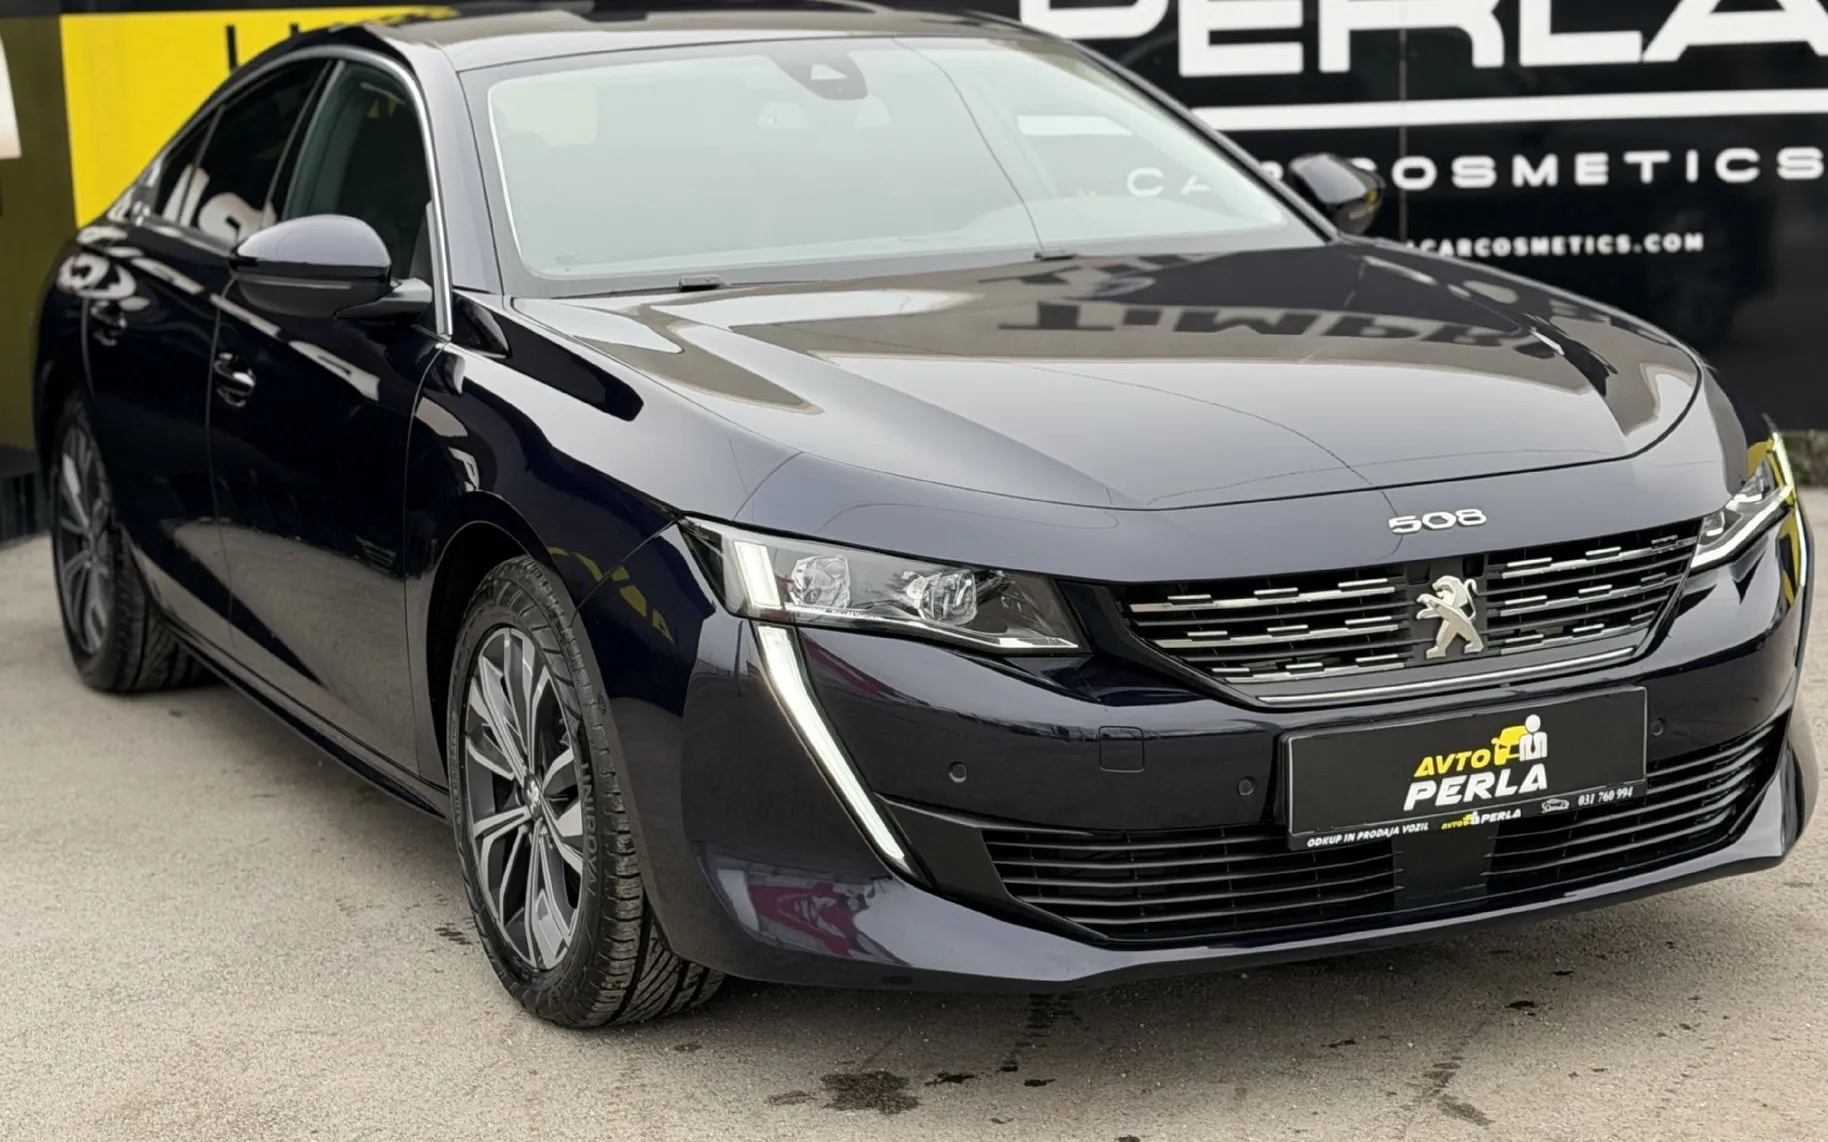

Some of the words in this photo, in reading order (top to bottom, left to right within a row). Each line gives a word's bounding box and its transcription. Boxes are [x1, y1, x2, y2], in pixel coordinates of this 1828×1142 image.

[1388, 508, 1487, 534] 508
[1413, 748, 1491, 778] AVTO
[1403, 763, 1548, 812] PERLA
[1578, 793, 1595, 806] 031
[1598, 789, 1615, 803] 760
[1616, 786, 1634, 800] 994
[1441, 819, 1464, 831] AVTO
[1480, 808, 1522, 824] PERLA
[1306, 834, 1342, 848] ODKUP
[1343, 832, 1356, 843] IN
[1357, 826, 1400, 841] PRODAJA
[1402, 821, 1429, 834] VOZIL
